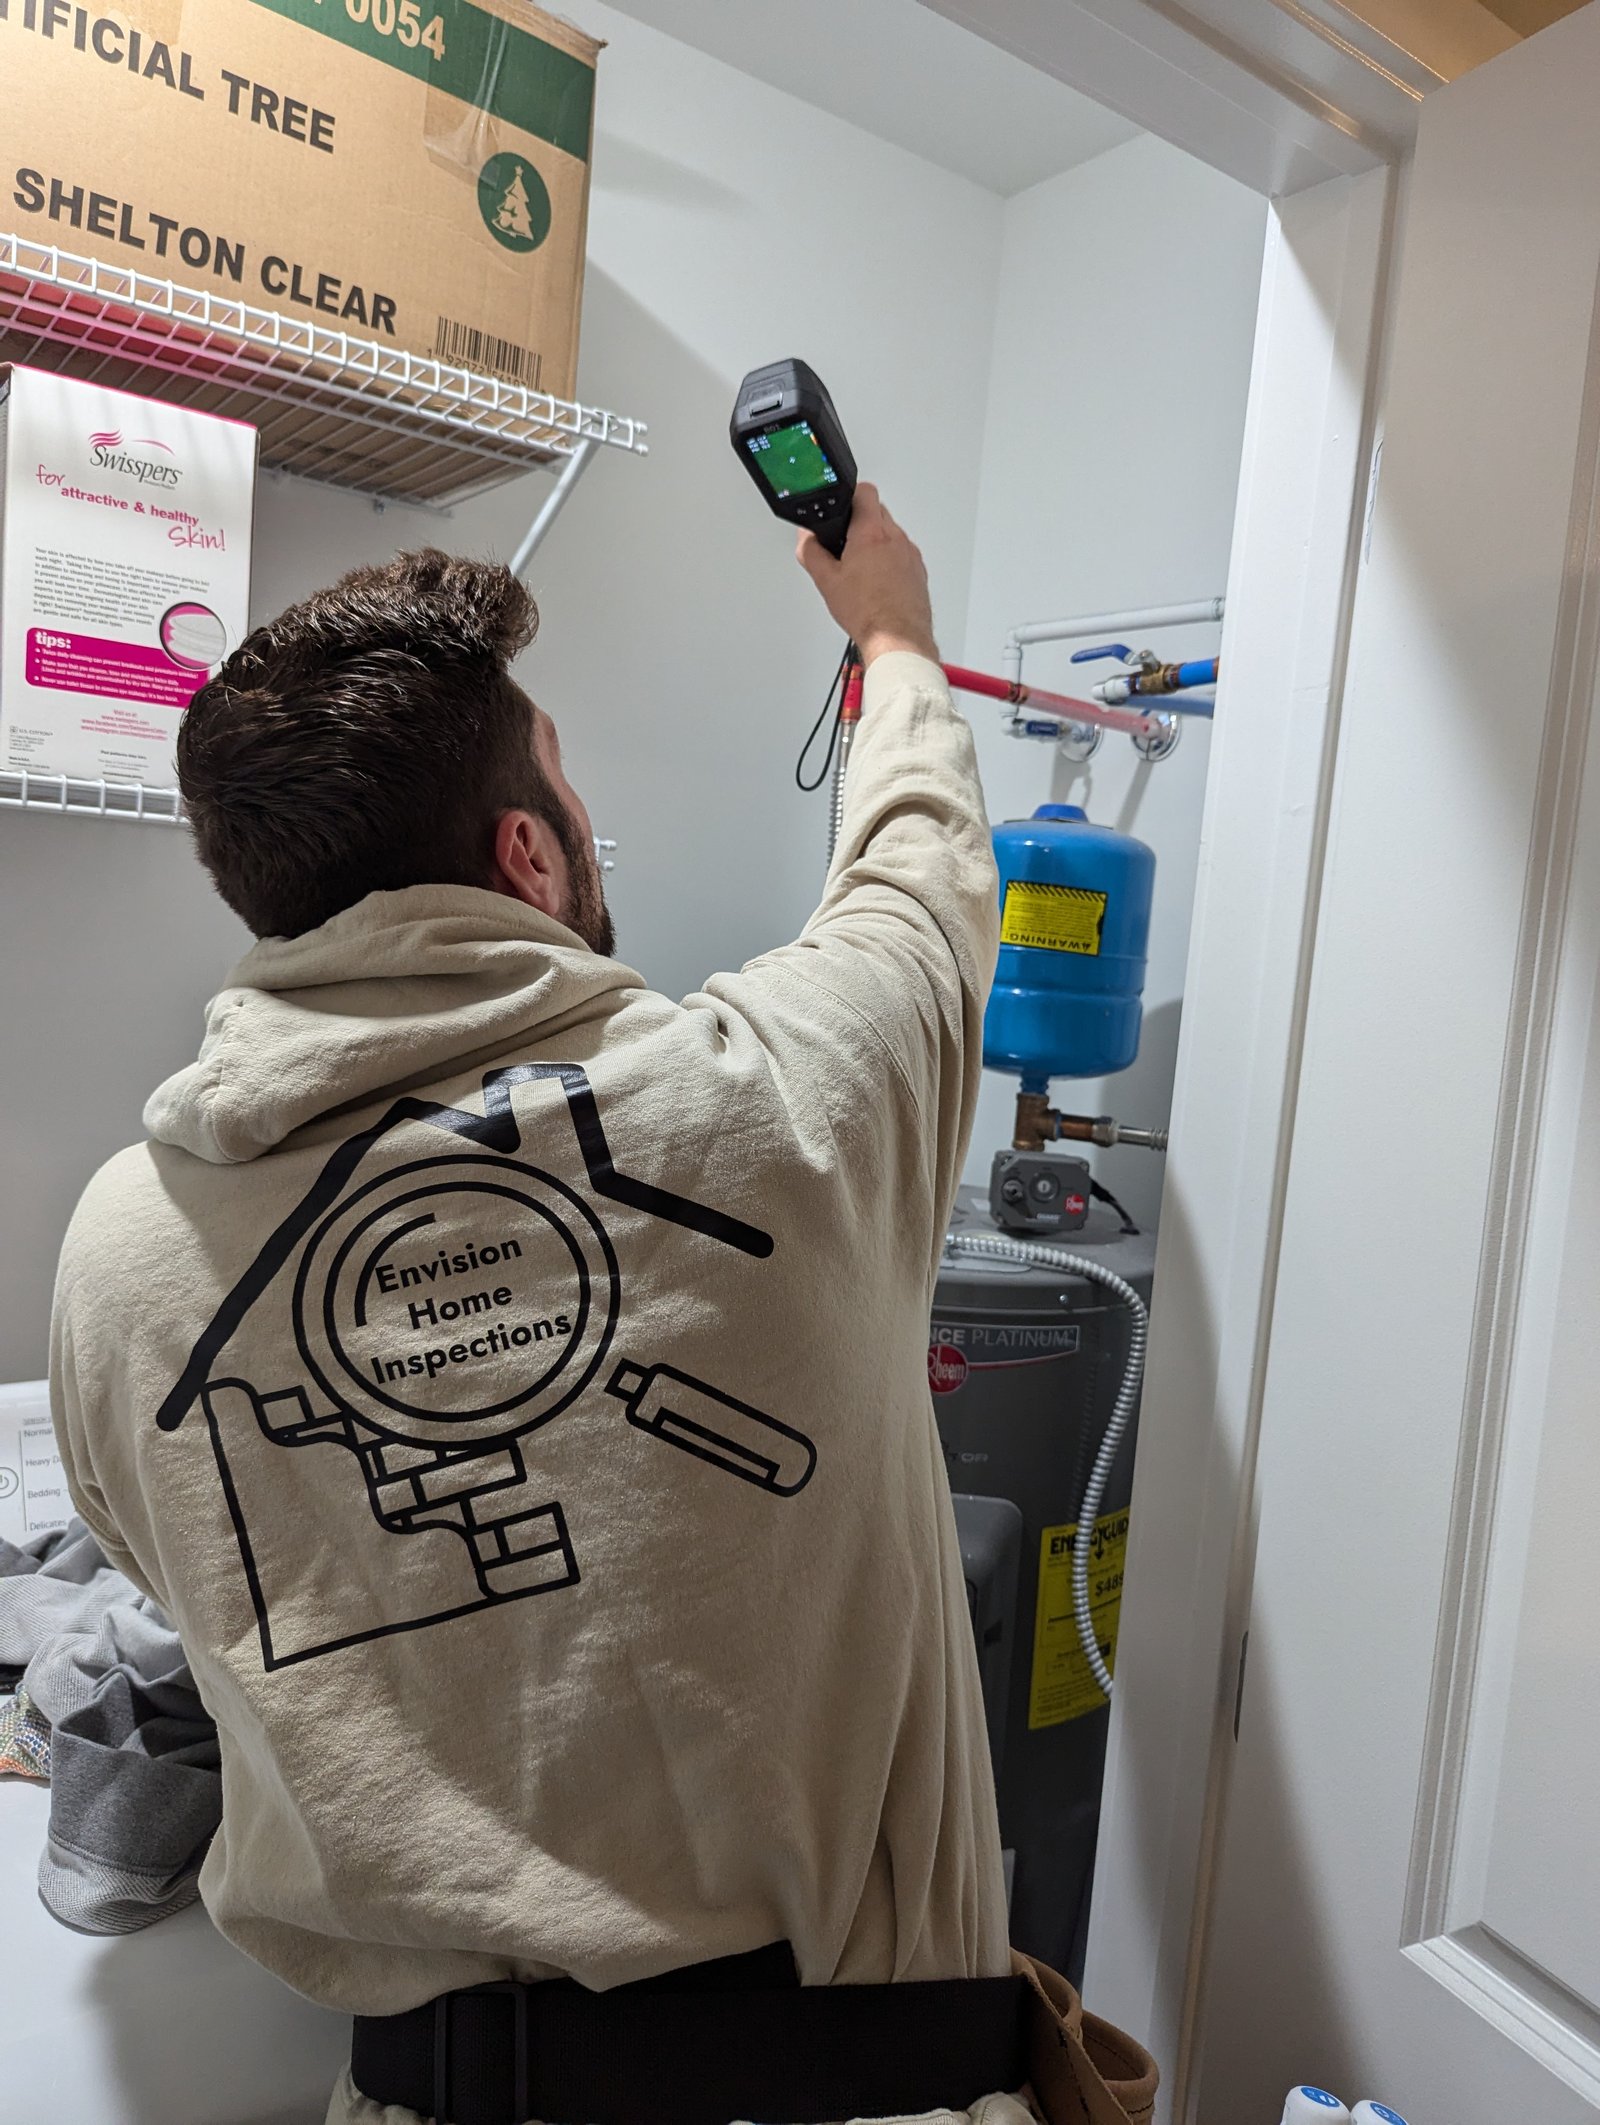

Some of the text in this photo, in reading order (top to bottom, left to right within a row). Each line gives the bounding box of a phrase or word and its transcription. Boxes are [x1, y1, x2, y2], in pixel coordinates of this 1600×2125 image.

[221, 69, 336, 154] TREE
[13, 167, 398, 336] SHELTON CLEAR
[36, 464, 66, 487] for
[90, 445, 182, 485] Swisspers
[61, 486, 199, 527] attractive & healthy
[168, 525, 226, 551] Skin!
[35, 632, 72, 650] tips:
[1006, 932, 1079, 949] WARNING!
[376, 1239, 523, 1293] Envision
[408, 1286, 513, 1330] Home
[370, 1314, 572, 1385] Inspections
[26, 1457, 50, 1468] Heavy
[27, 1488, 61, 1499] Bedding
[29, 1519, 67, 1531] Delicates
